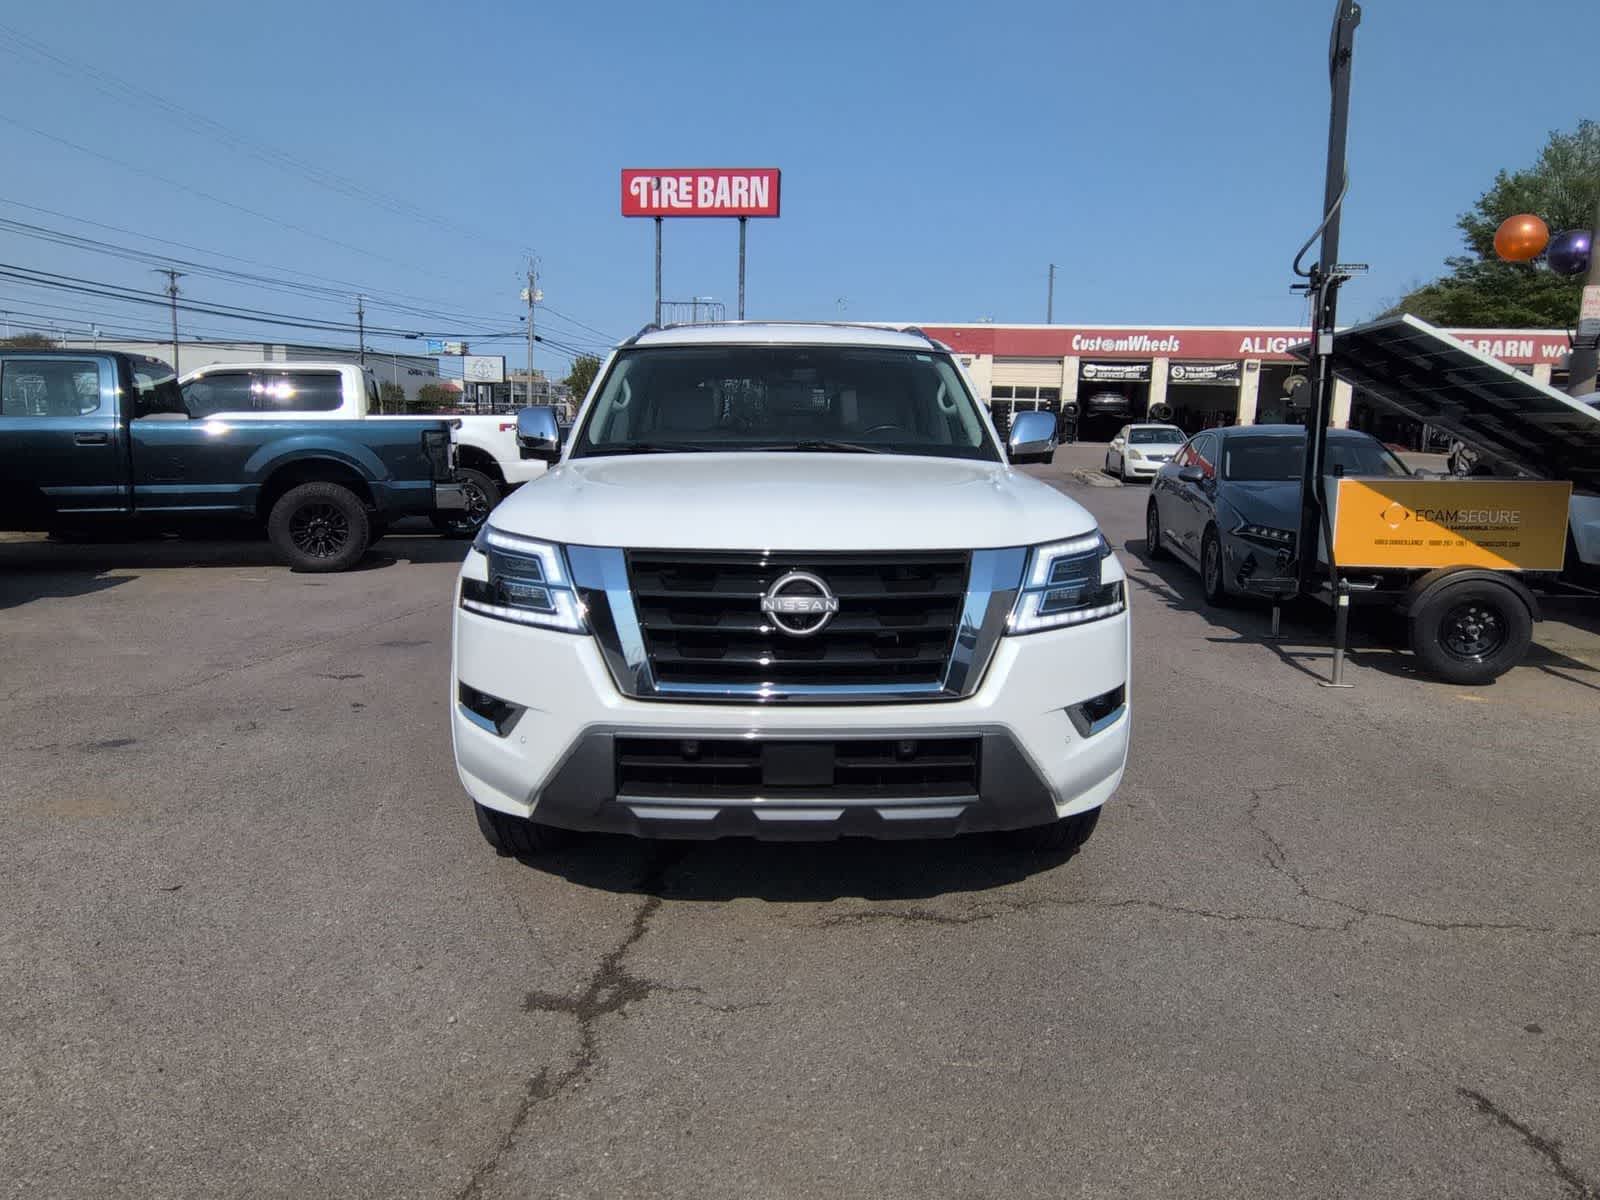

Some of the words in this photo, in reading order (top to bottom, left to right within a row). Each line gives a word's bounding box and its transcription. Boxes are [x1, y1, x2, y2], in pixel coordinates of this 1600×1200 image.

[697, 176, 769, 208] BARN
[1239, 337, 1311, 353] ALIGN
[1476, 340, 1534, 358] BARN
[1415, 509, 1521, 524] ECAMSECURE
[762, 600, 838, 611] NISSAN
